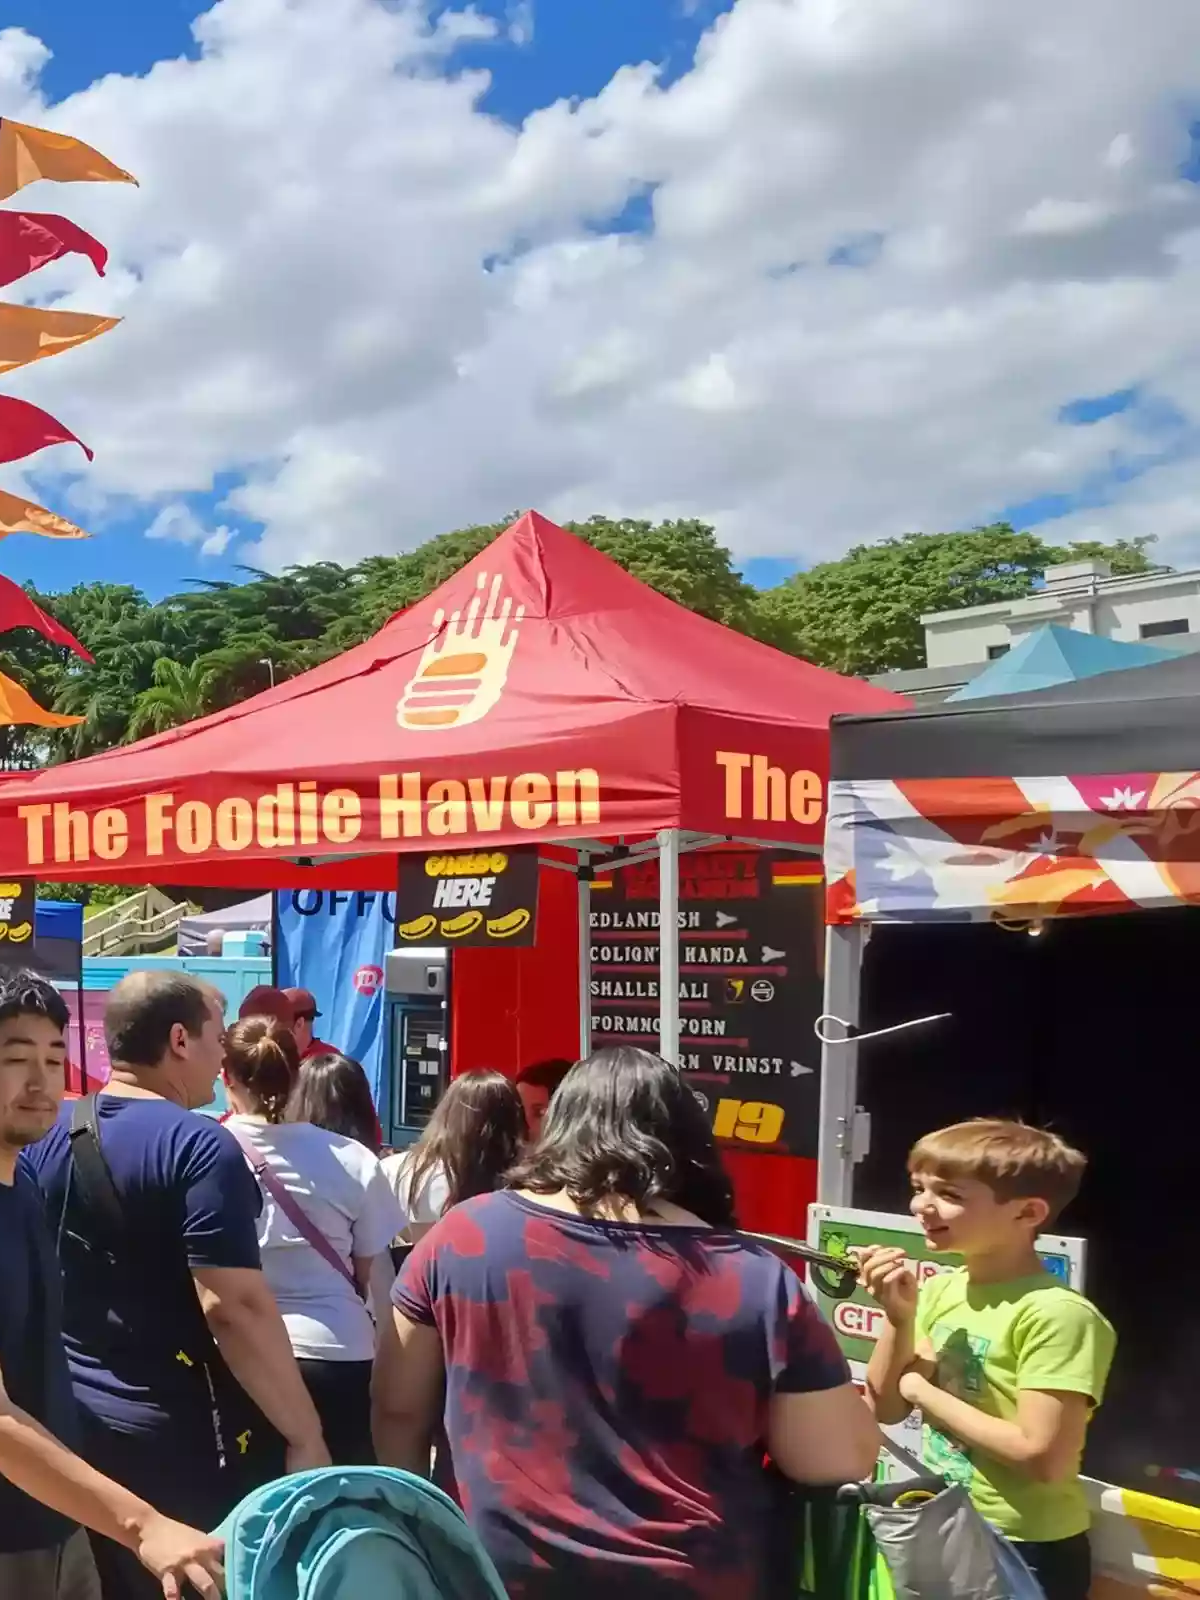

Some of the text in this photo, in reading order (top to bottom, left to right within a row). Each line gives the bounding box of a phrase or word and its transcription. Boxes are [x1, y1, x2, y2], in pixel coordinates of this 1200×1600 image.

[716, 750, 823, 825] The
[18, 768, 600, 864] The Foodie Haven
[432, 876, 497, 909] HERE
[685, 945, 749, 964] HANDA
[711, 1097, 786, 1144] 19
